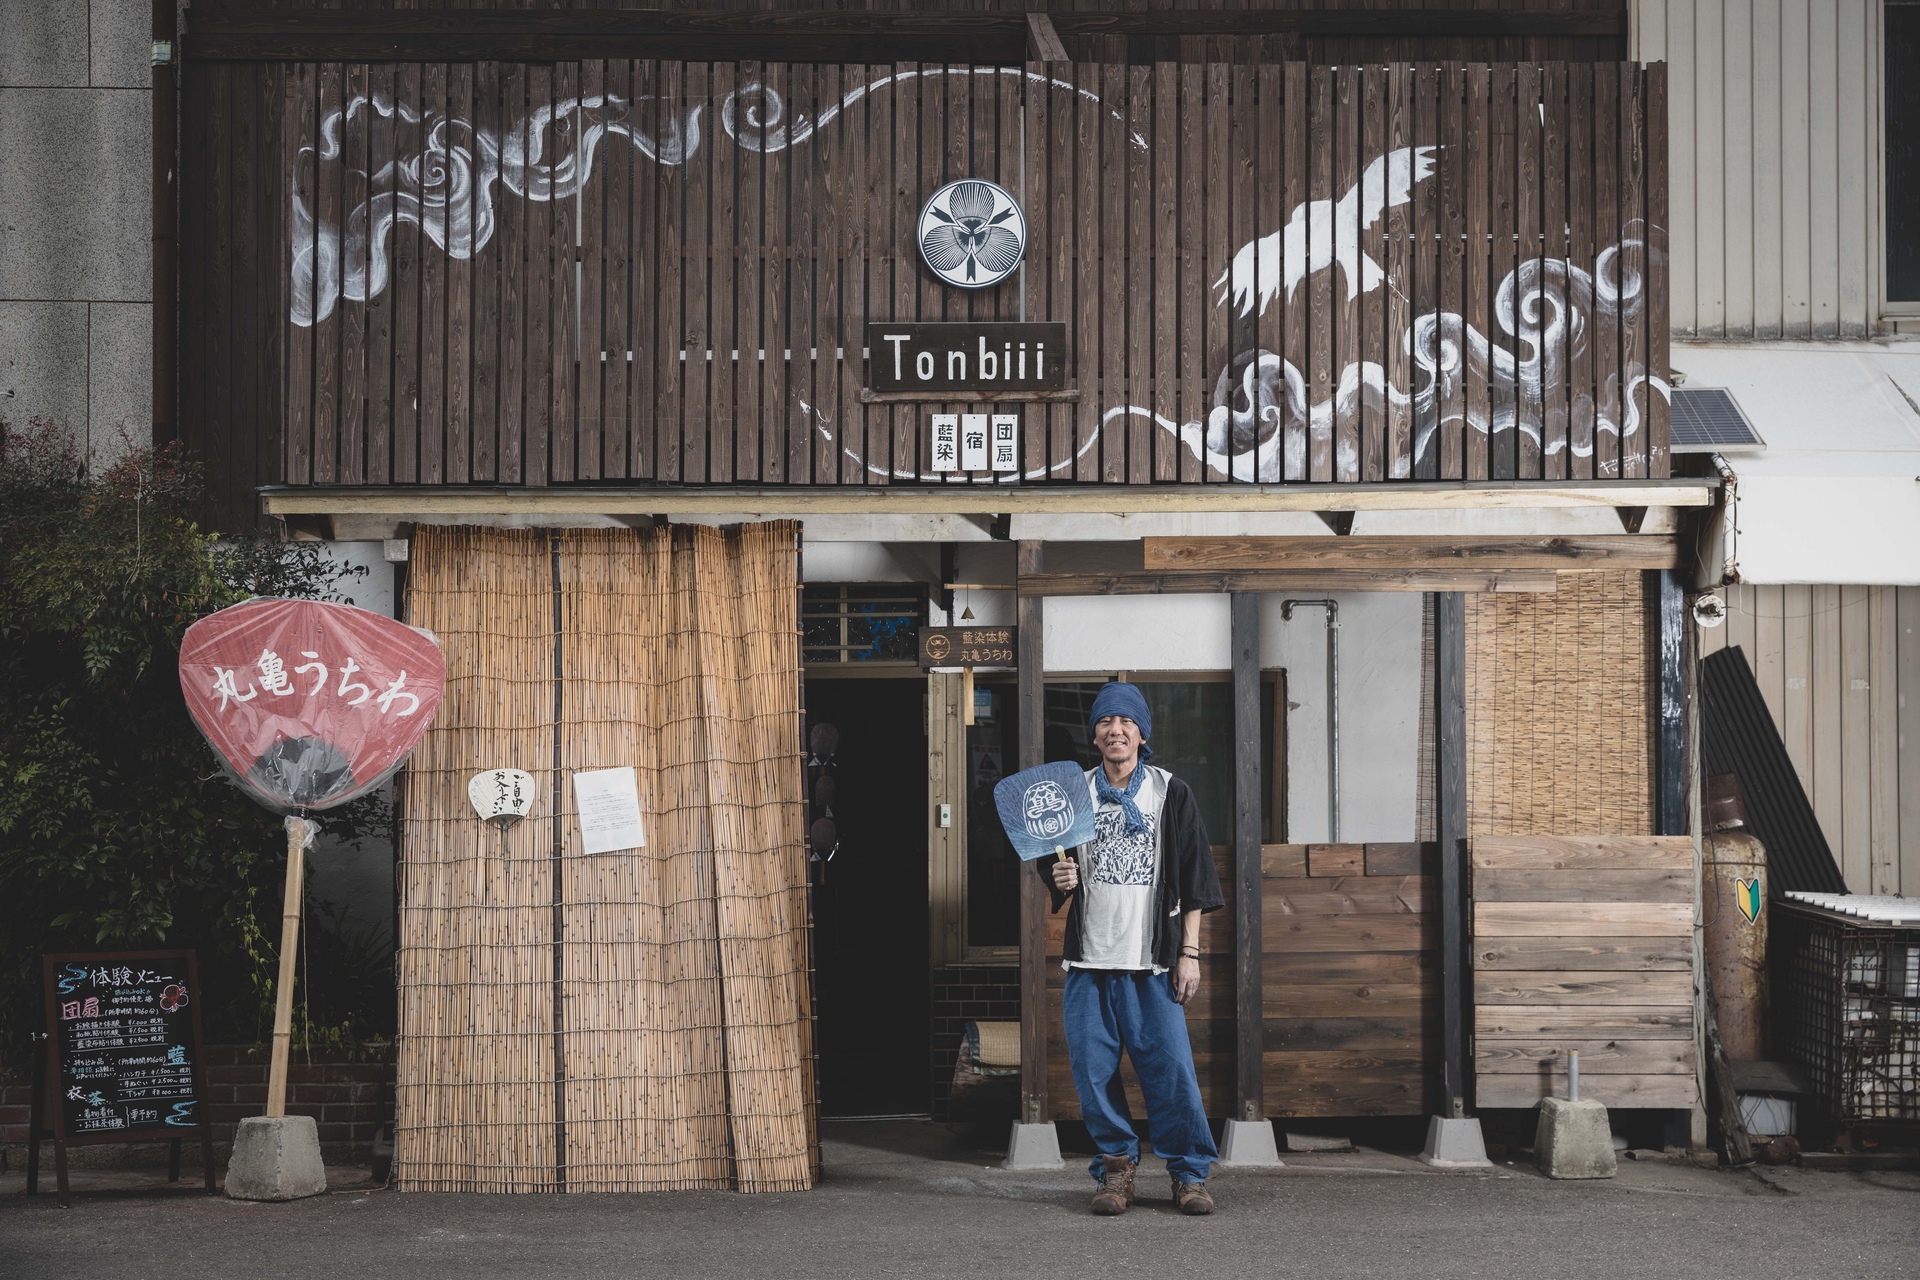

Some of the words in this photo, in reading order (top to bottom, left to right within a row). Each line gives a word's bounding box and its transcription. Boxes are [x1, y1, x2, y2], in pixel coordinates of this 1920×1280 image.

[883, 334, 1044, 380] Tonbiii
[937, 423, 954, 461] 藍染
[966, 431, 984, 450] 宿
[996, 423, 1013, 462] 団扇
[962, 630, 1009, 644] 藍染体験
[960, 648, 1013, 662] 丸亀うちわ
[213, 648, 420, 717] 丸亀うちわ
[512, 774, 525, 814] ご自由に
[90, 966, 172, 987] 体験メニュー
[61, 996, 99, 1020] 団扇
[168, 1045, 187, 1065] 藍
